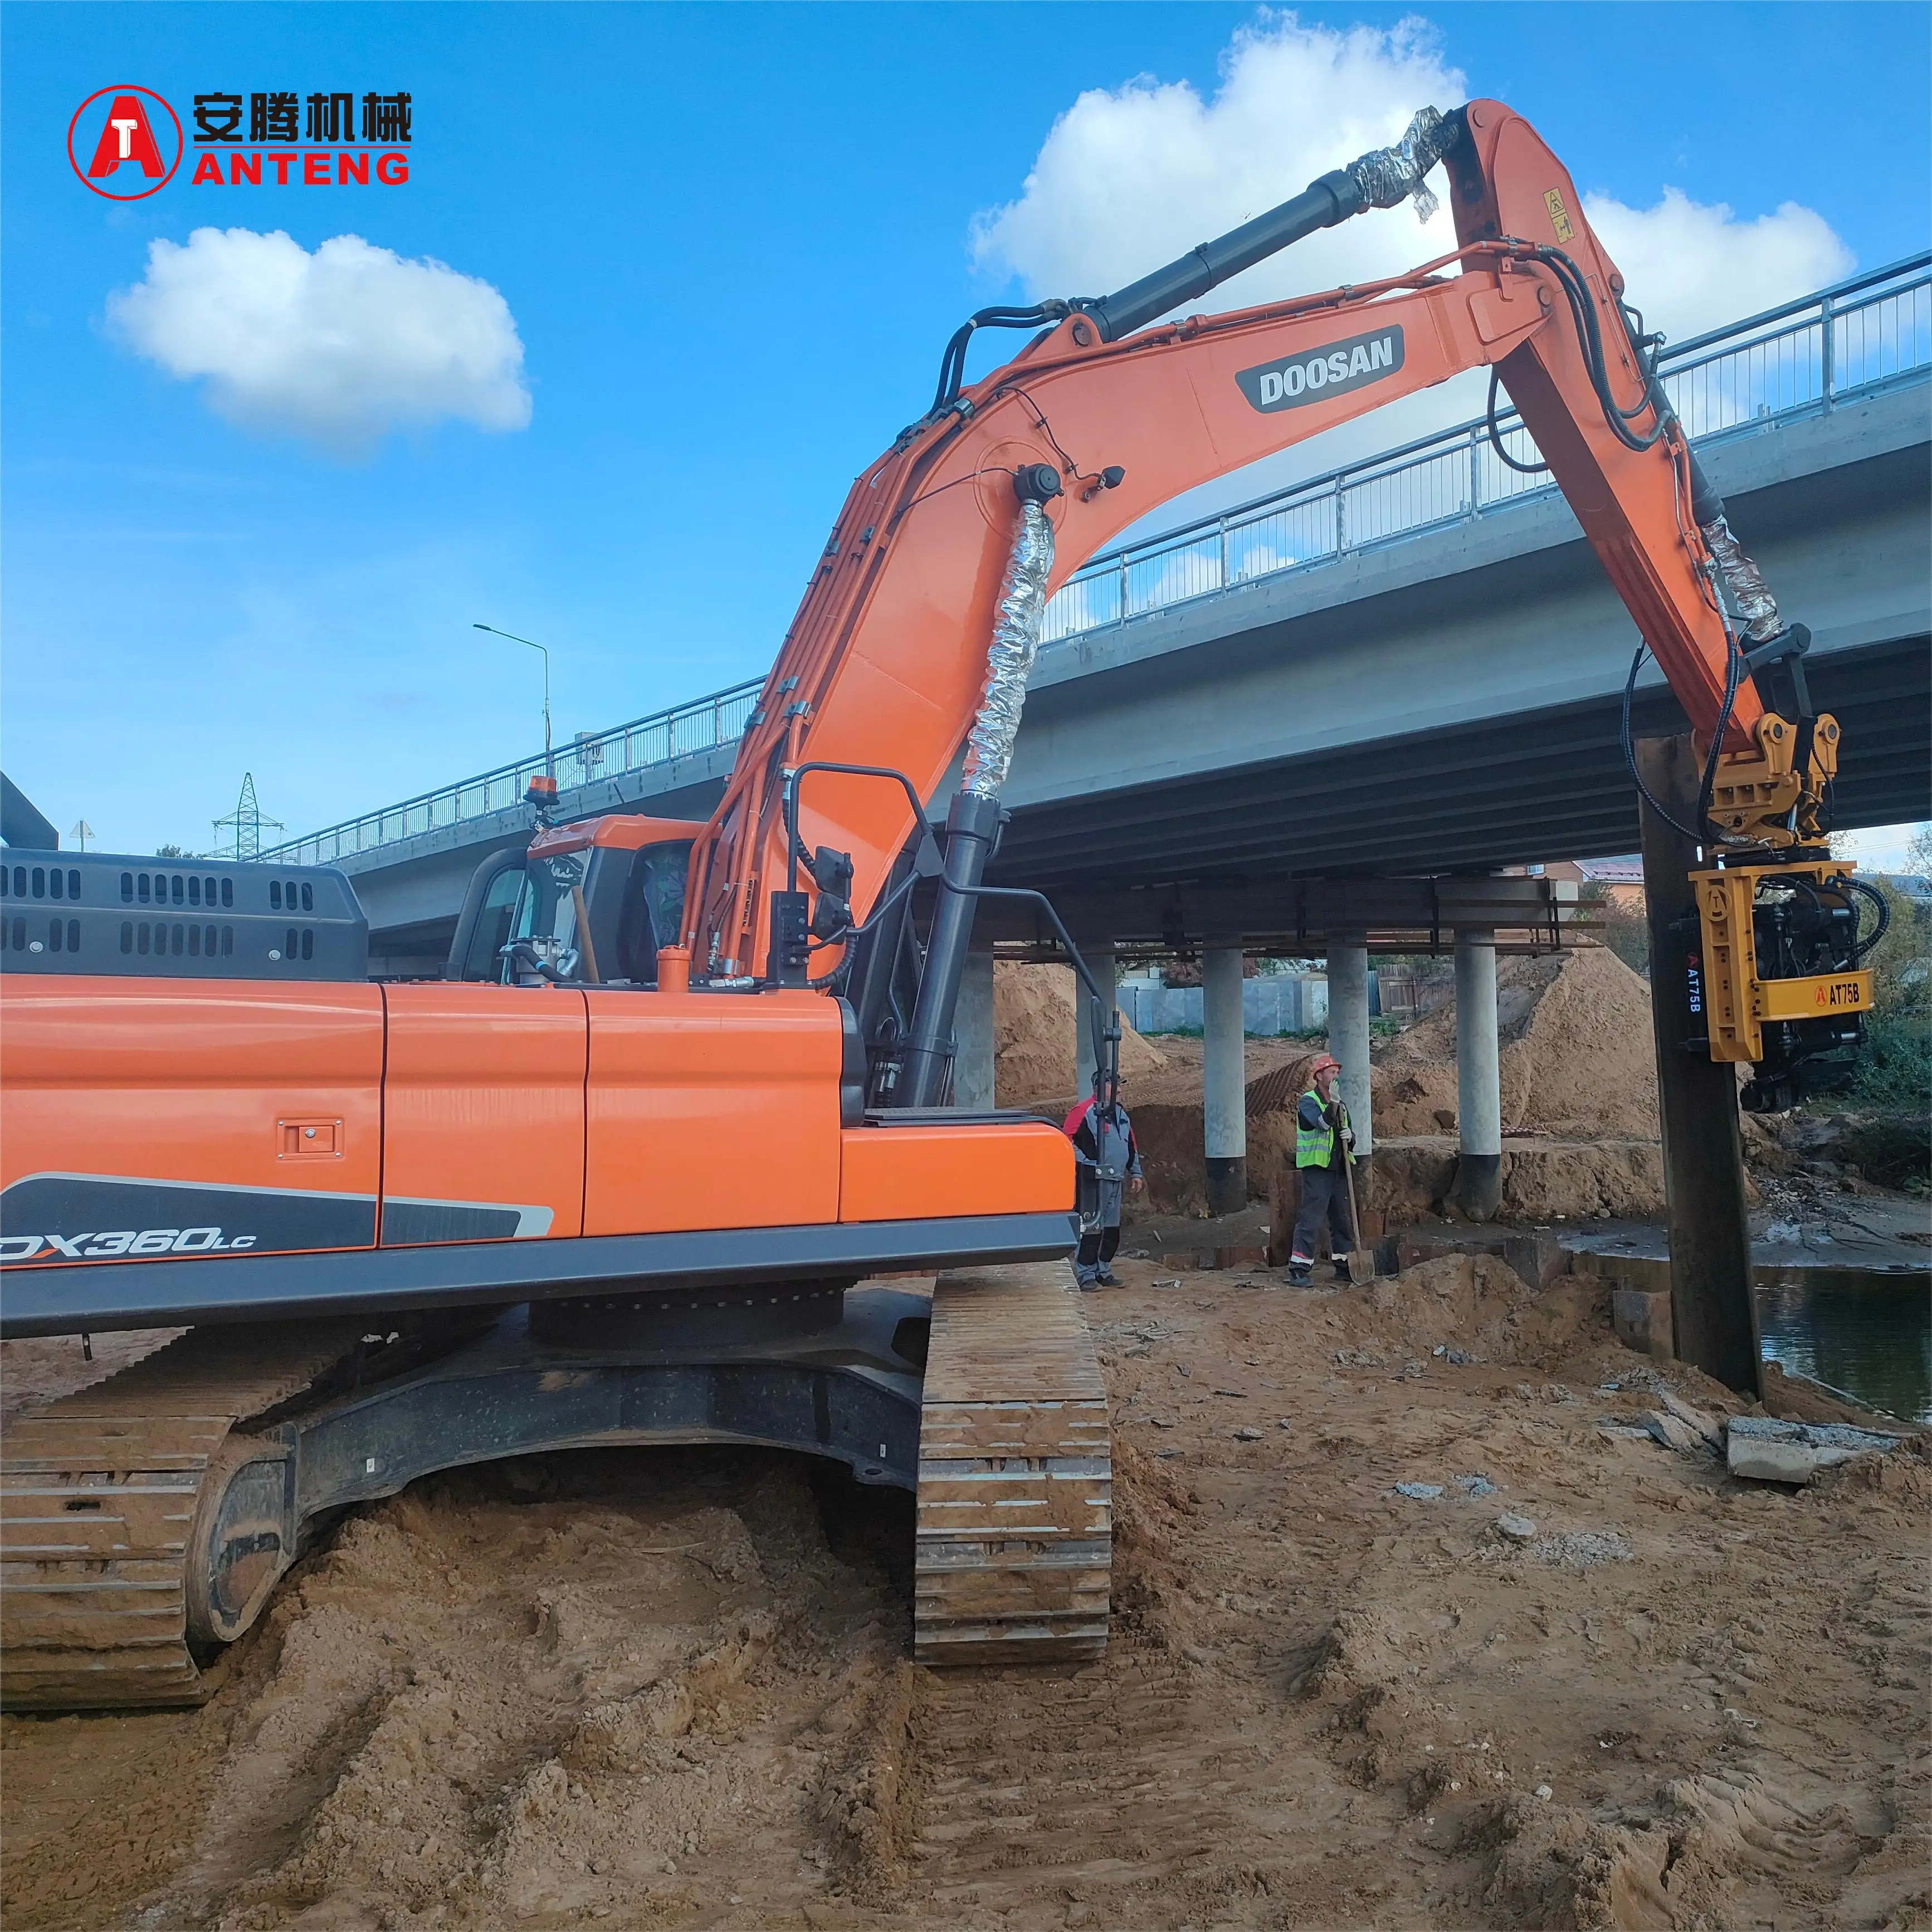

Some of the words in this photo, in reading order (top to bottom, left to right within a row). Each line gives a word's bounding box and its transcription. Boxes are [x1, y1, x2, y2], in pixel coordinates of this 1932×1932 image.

[1260, 336, 1393, 405] DOOSAN
[1687, 969, 1701, 1012] AT75B
[1829, 982, 1860, 1006] AT75B
